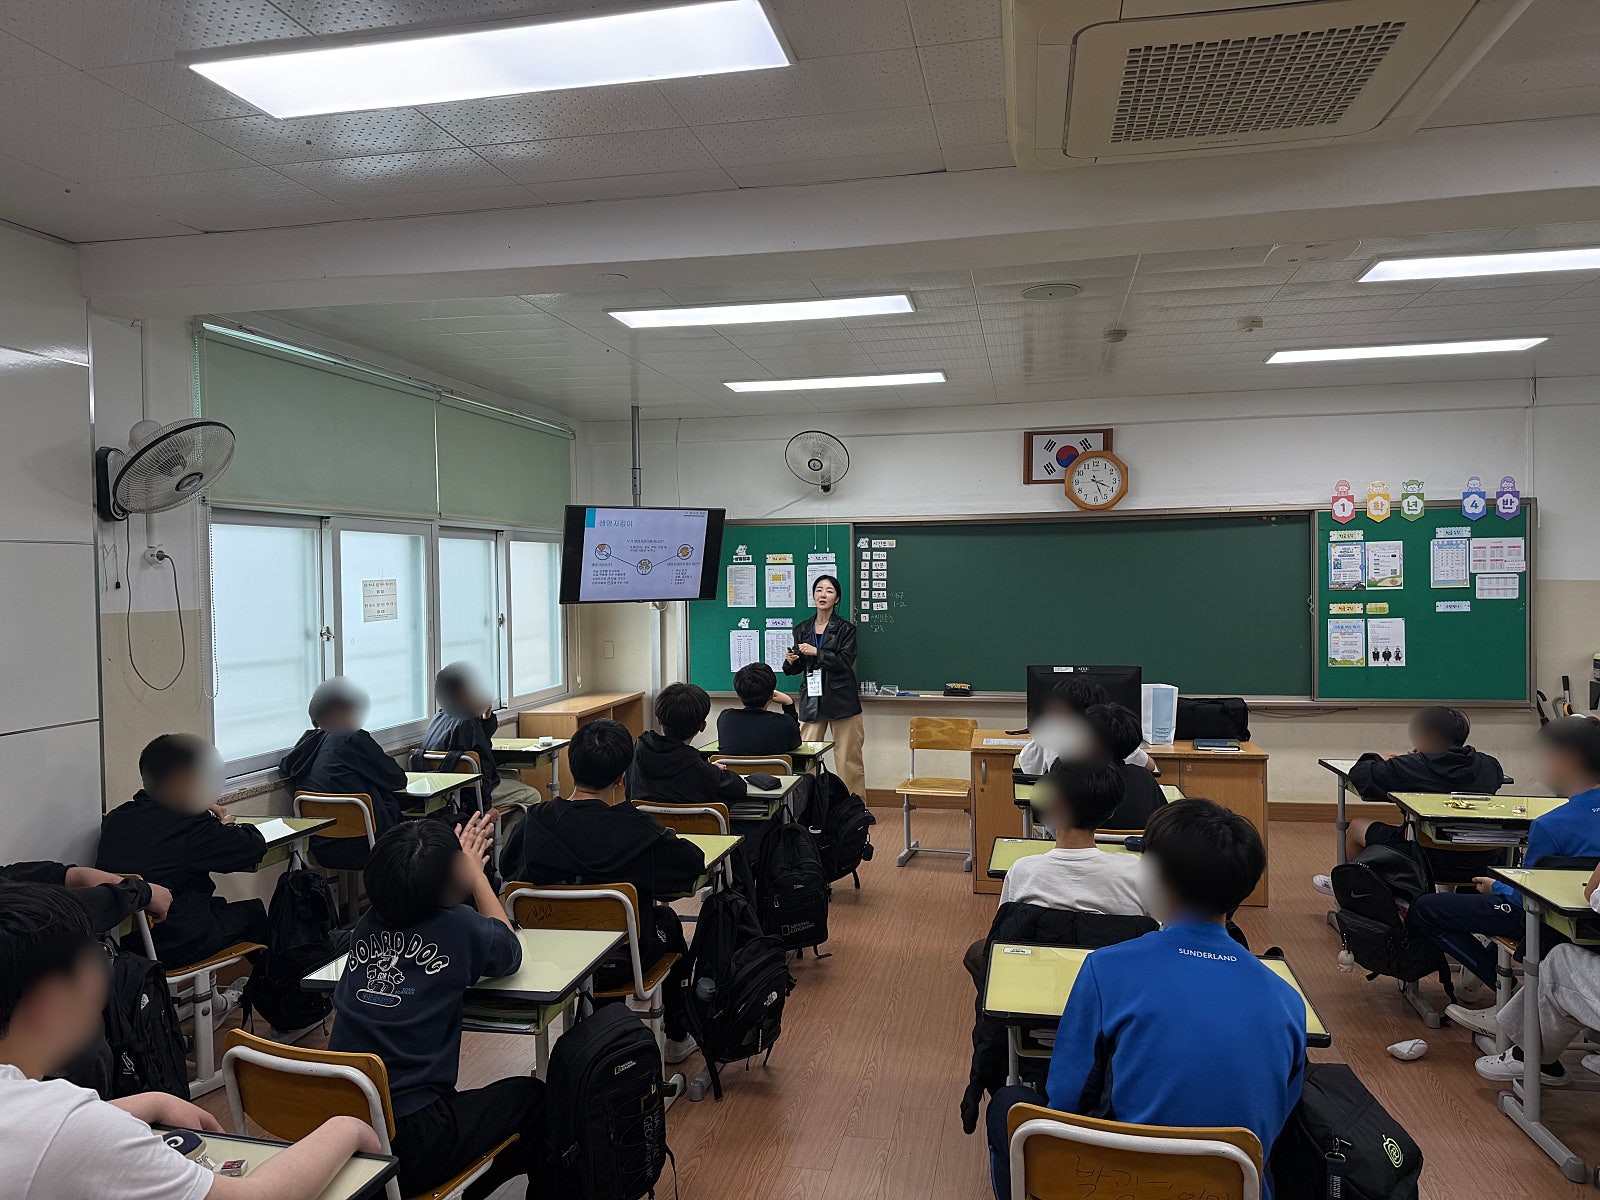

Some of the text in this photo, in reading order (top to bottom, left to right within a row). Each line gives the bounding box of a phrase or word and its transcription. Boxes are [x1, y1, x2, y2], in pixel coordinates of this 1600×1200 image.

[348, 931, 450, 974] BOARD DOG
[1178, 948, 1237, 962] SUNDERLAND
